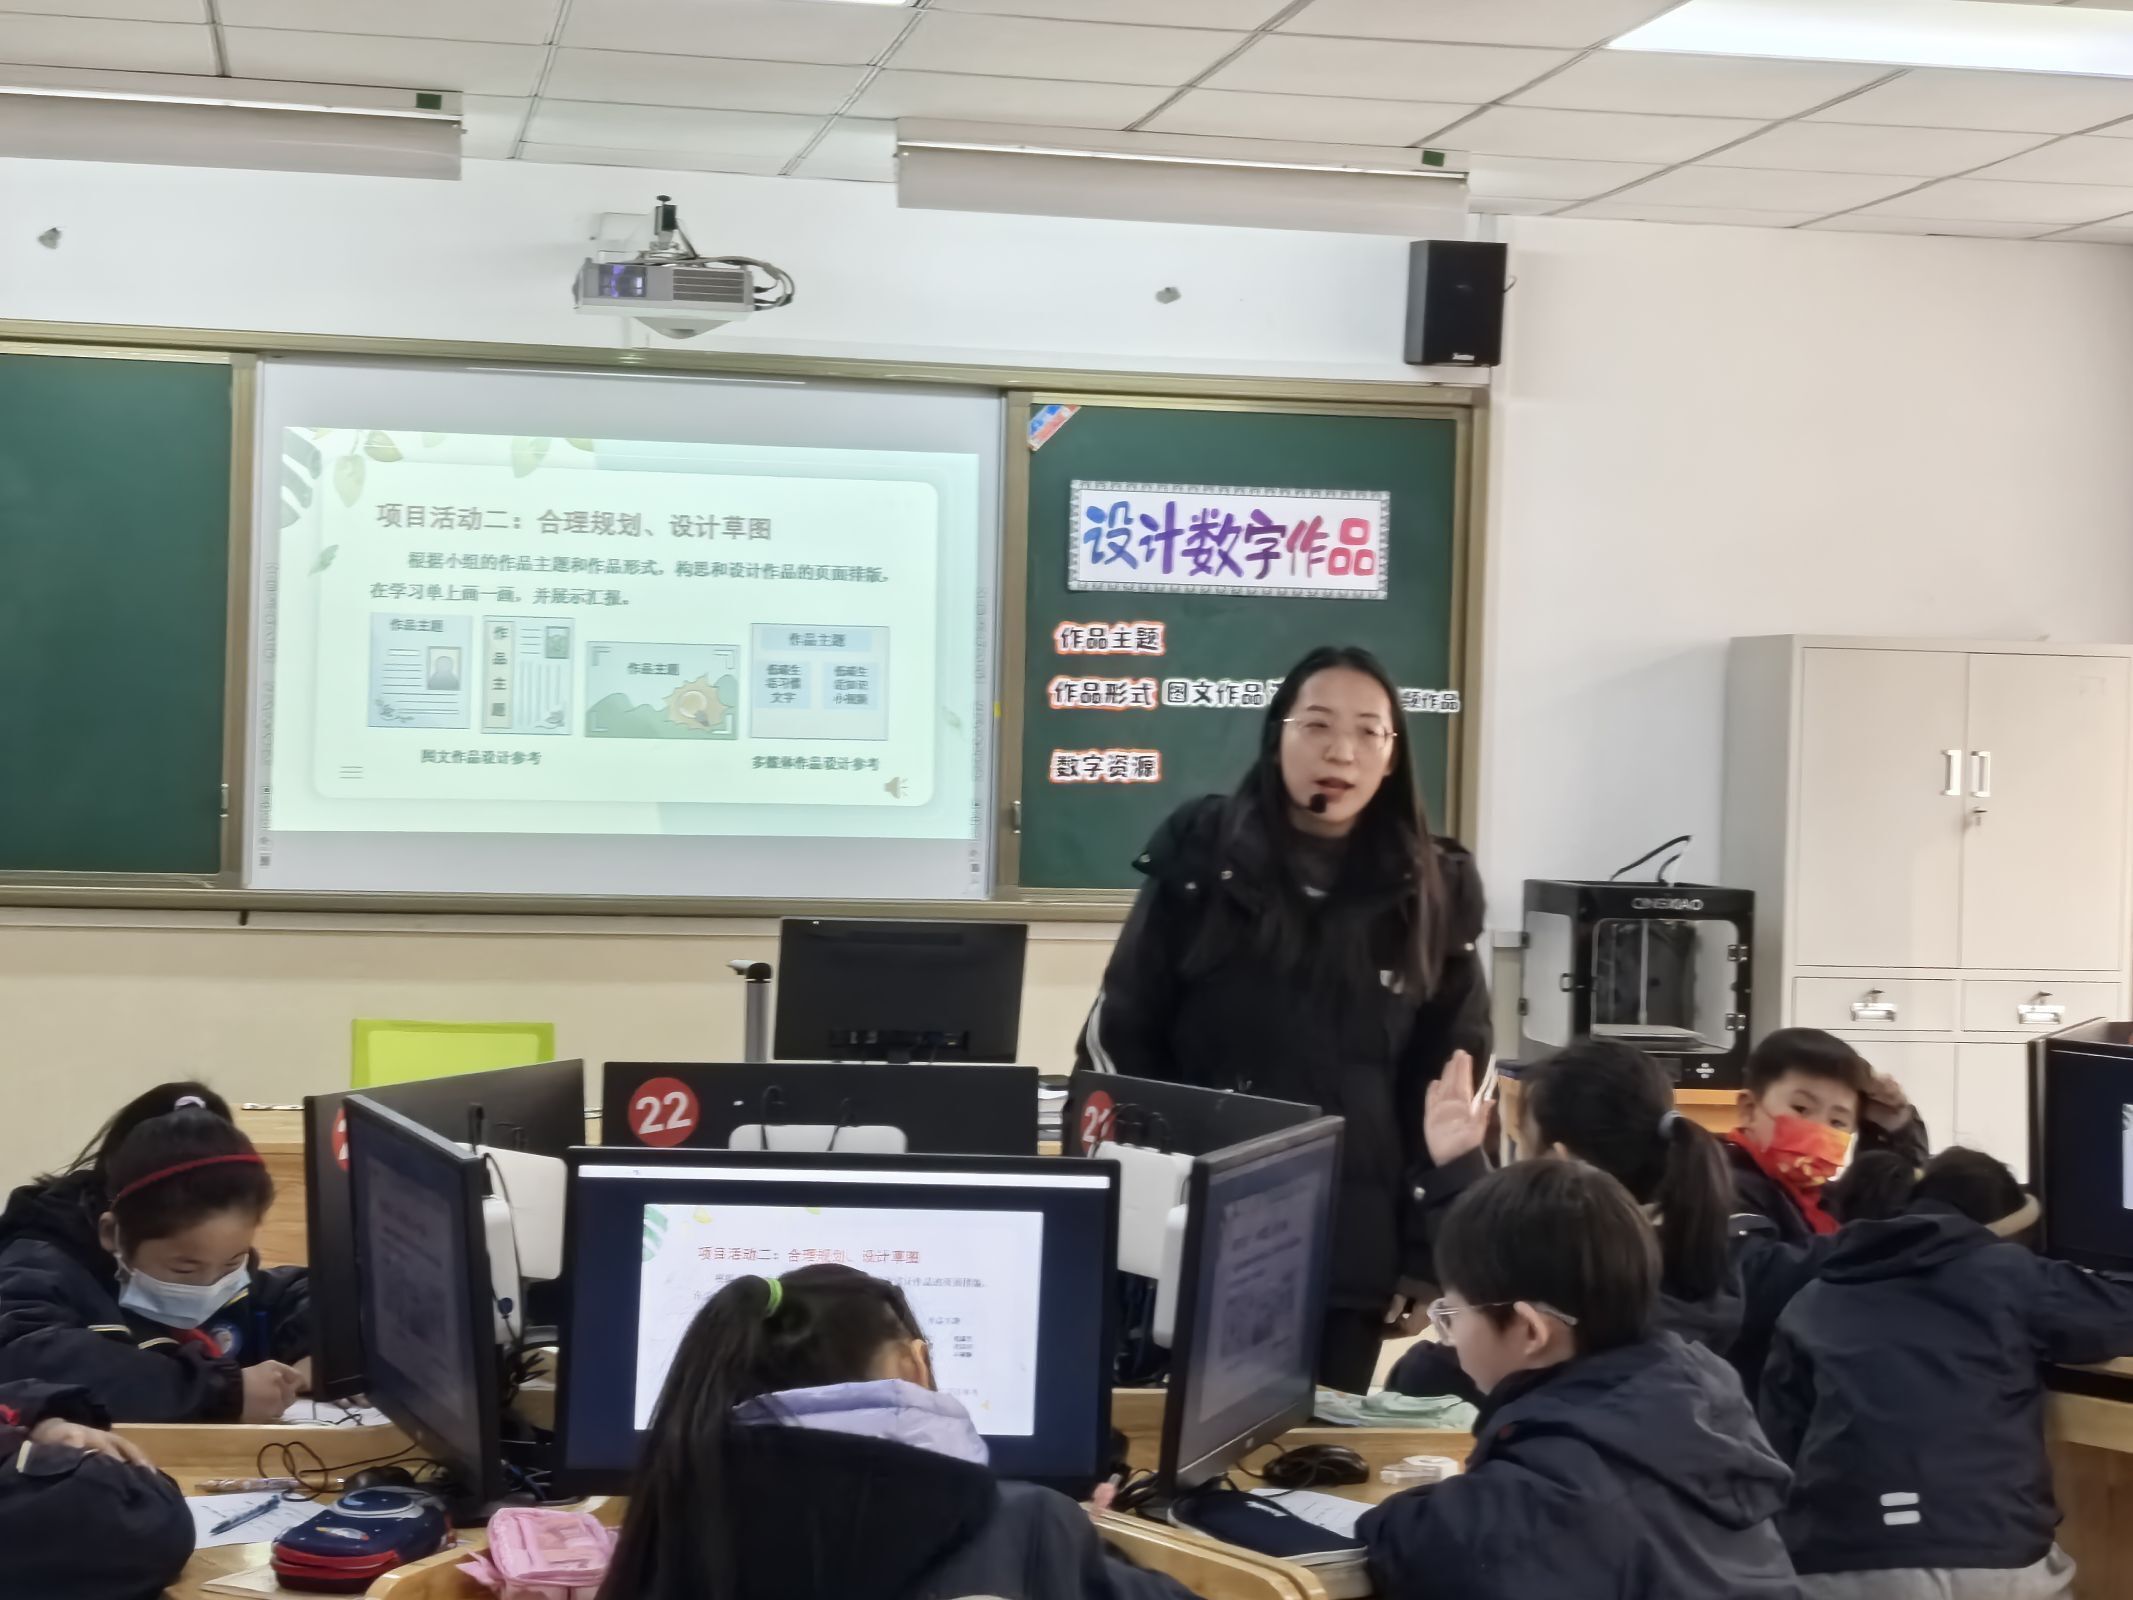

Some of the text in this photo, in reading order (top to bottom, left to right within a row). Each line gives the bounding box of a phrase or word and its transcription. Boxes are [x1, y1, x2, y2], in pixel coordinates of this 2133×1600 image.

[376, 503, 773, 541] 项目活动二：合理规划、设计草图
[1083, 500, 1376, 580] 设计数字作品
[1060, 626, 1162, 652] 作品主题
[1055, 681, 1153, 707] 作品形式
[1167, 681, 1264, 706] 图文作品
[1057, 754, 1156, 779] 数字资源
[635, 1091, 693, 1135] 22
